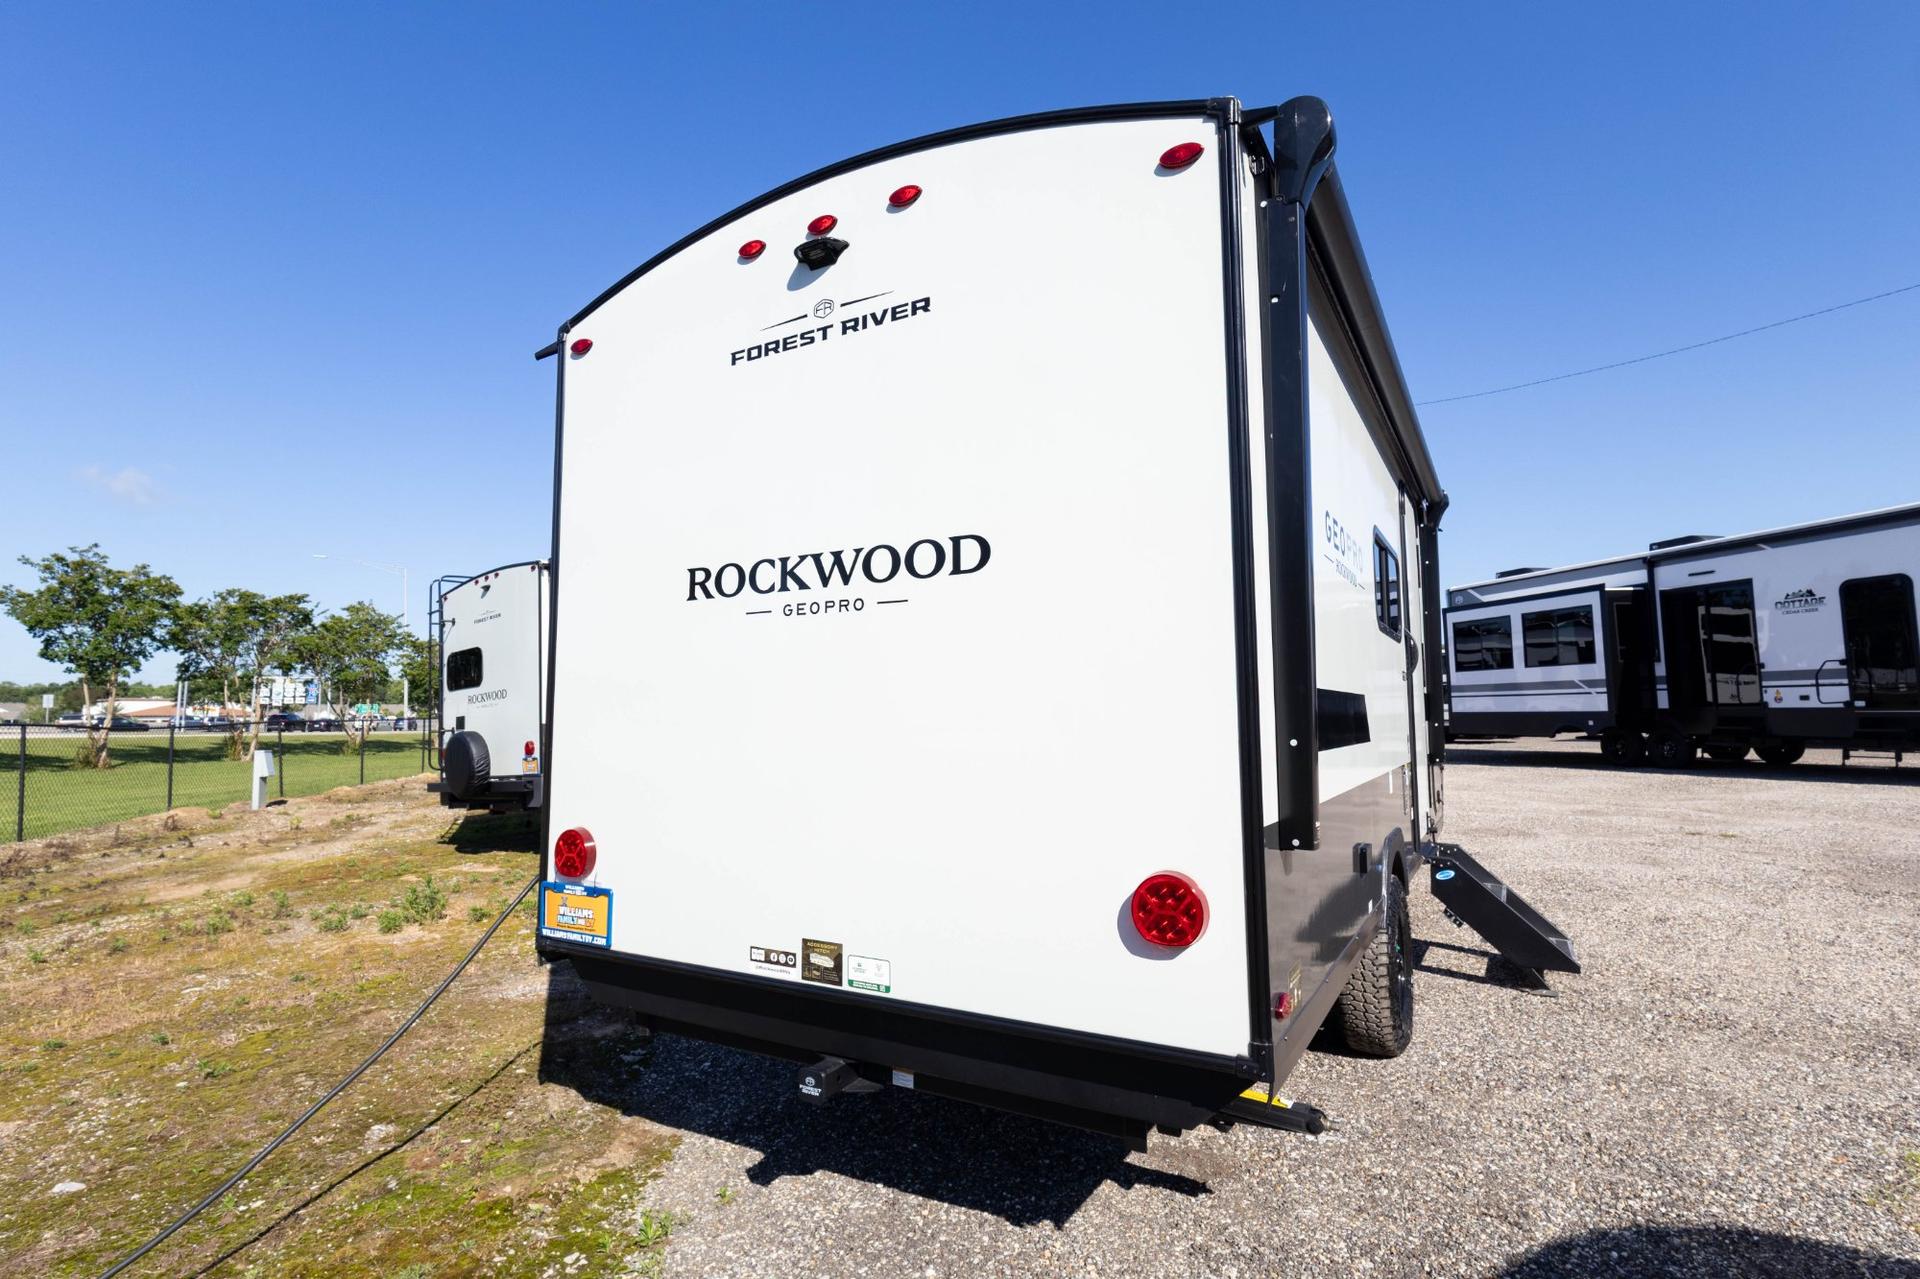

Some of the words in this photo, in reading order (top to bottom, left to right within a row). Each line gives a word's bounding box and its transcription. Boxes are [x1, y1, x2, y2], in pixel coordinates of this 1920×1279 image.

[731, 324, 834, 366] FOREST
[840, 297, 931, 336] RIVER
[1325, 510, 1363, 574] GEOPRO
[686, 534, 992, 602] ROCKWOOD
[782, 598, 865, 617] GEOPRO
[1774, 596, 1827, 611] COTTAGE
[468, 689, 508, 705] ROCKWOOD
